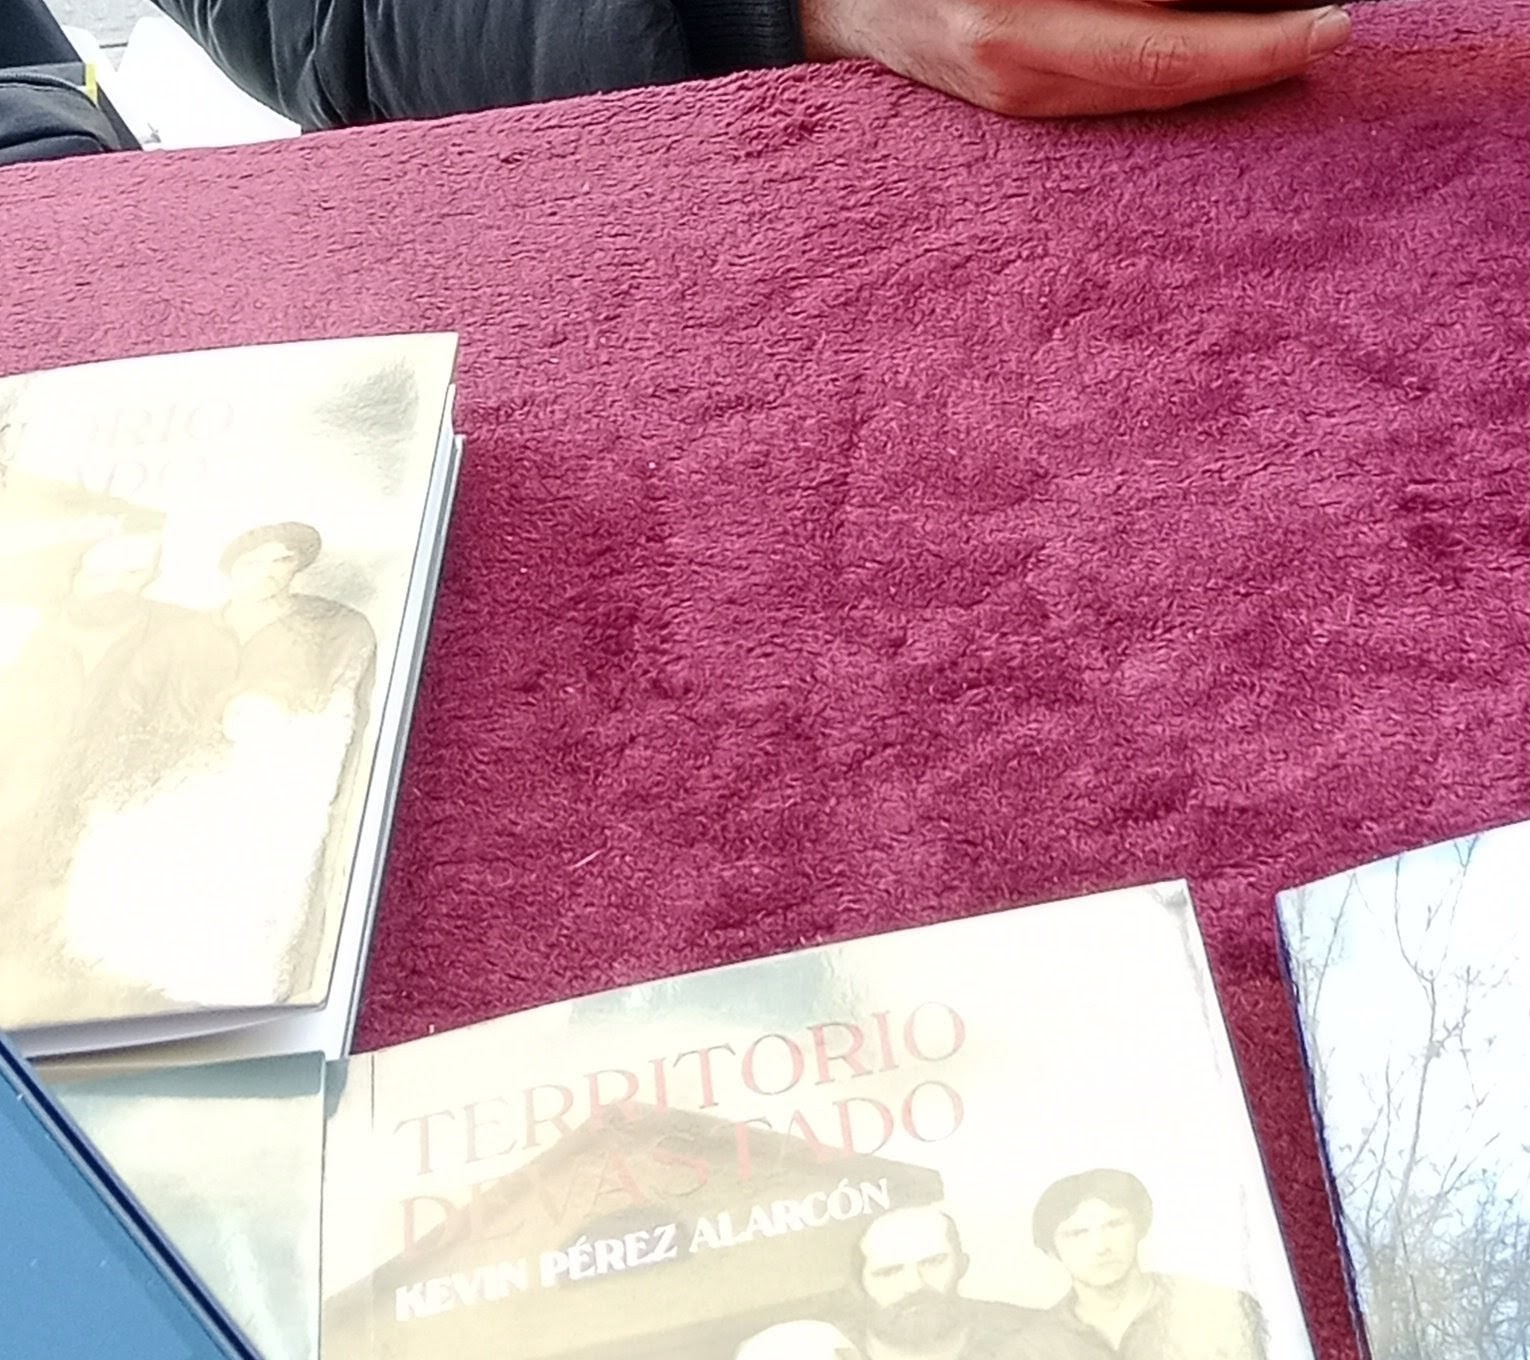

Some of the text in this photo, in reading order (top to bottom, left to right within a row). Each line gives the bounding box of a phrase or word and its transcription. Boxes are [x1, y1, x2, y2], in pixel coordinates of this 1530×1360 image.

[394, 1000, 967, 1177] TERRITORIO
[398, 1079, 965, 1262] DEVASTADO
[395, 1177, 892, 1322] KEVIN PÉREZ ALARCÓN
